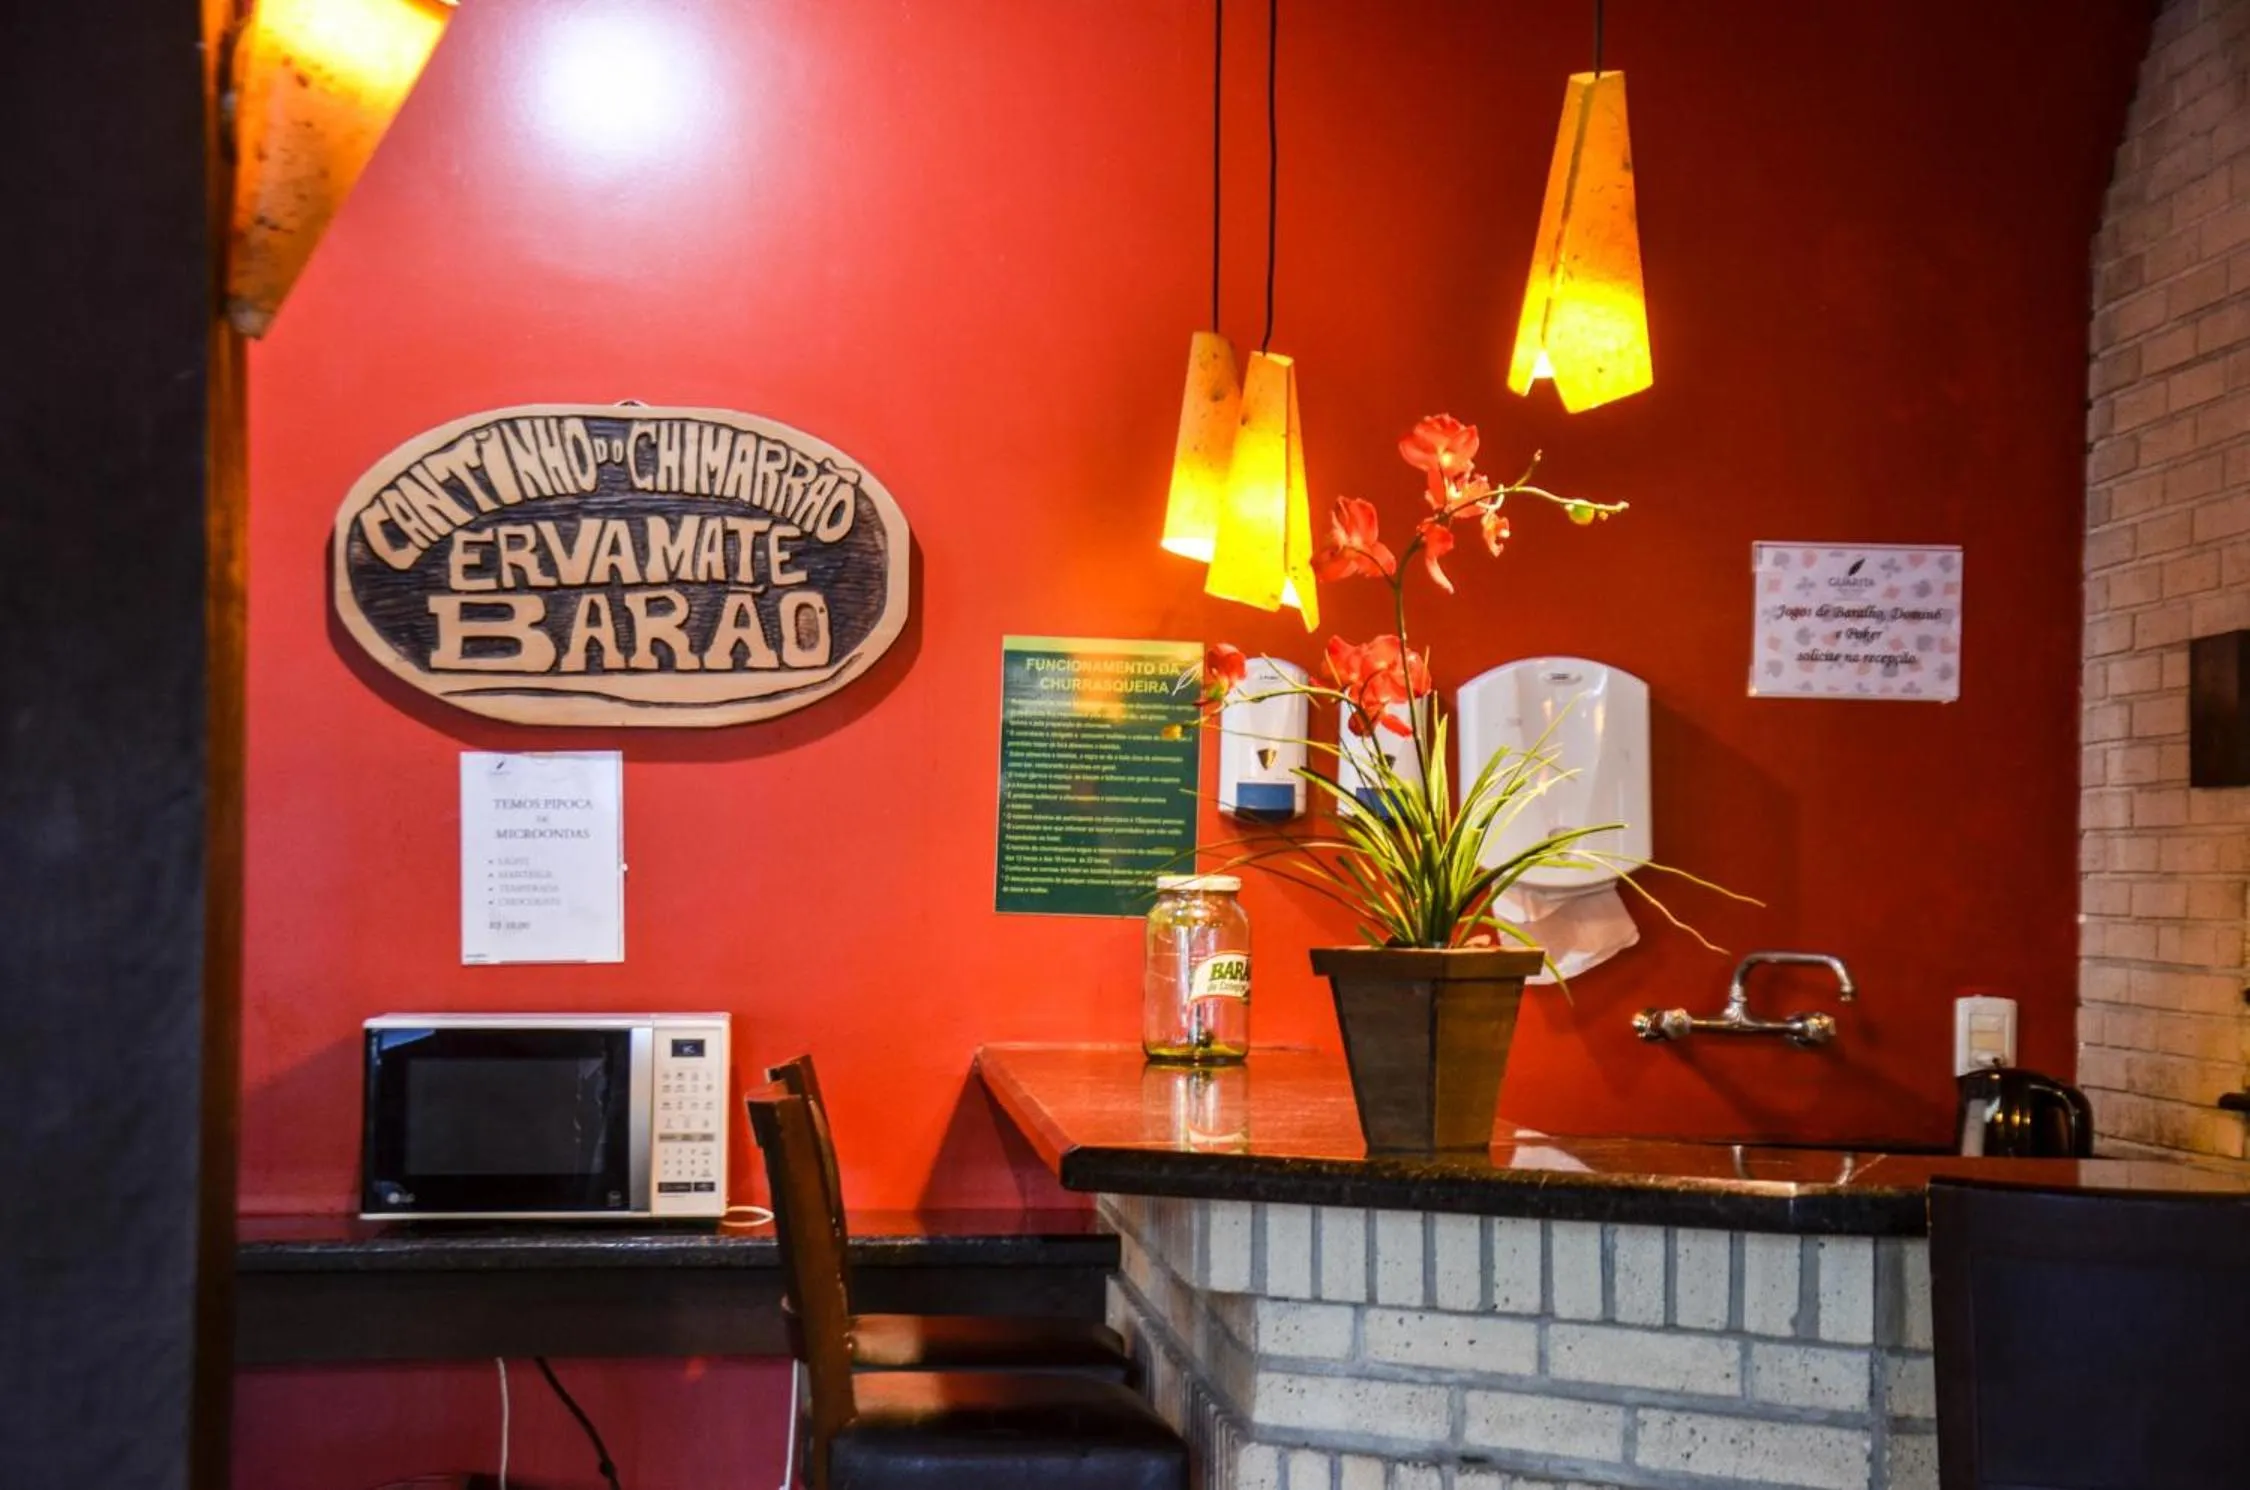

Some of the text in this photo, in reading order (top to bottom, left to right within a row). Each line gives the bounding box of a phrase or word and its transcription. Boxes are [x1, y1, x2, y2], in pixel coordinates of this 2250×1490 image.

[597, 438, 624, 465] DO
[626, 419, 862, 543] CHIMARRÃO
[1775, 604, 1812, 621] Jogos
[1815, 604, 1830, 619] de
[428, 585, 831, 672] BARÃO
[1847, 626, 1882, 643] Poker
[1797, 648, 1840, 663] solicite
[1845, 654, 1860, 663] na
[1026, 658, 1181, 677] FUNCIONAMENTO DA
[1039, 676, 1170, 694] CHURRASQUEIRA
[494, 798, 593, 810] TEMOS PIPOCA
[495, 828, 590, 840] MICROONDAS
